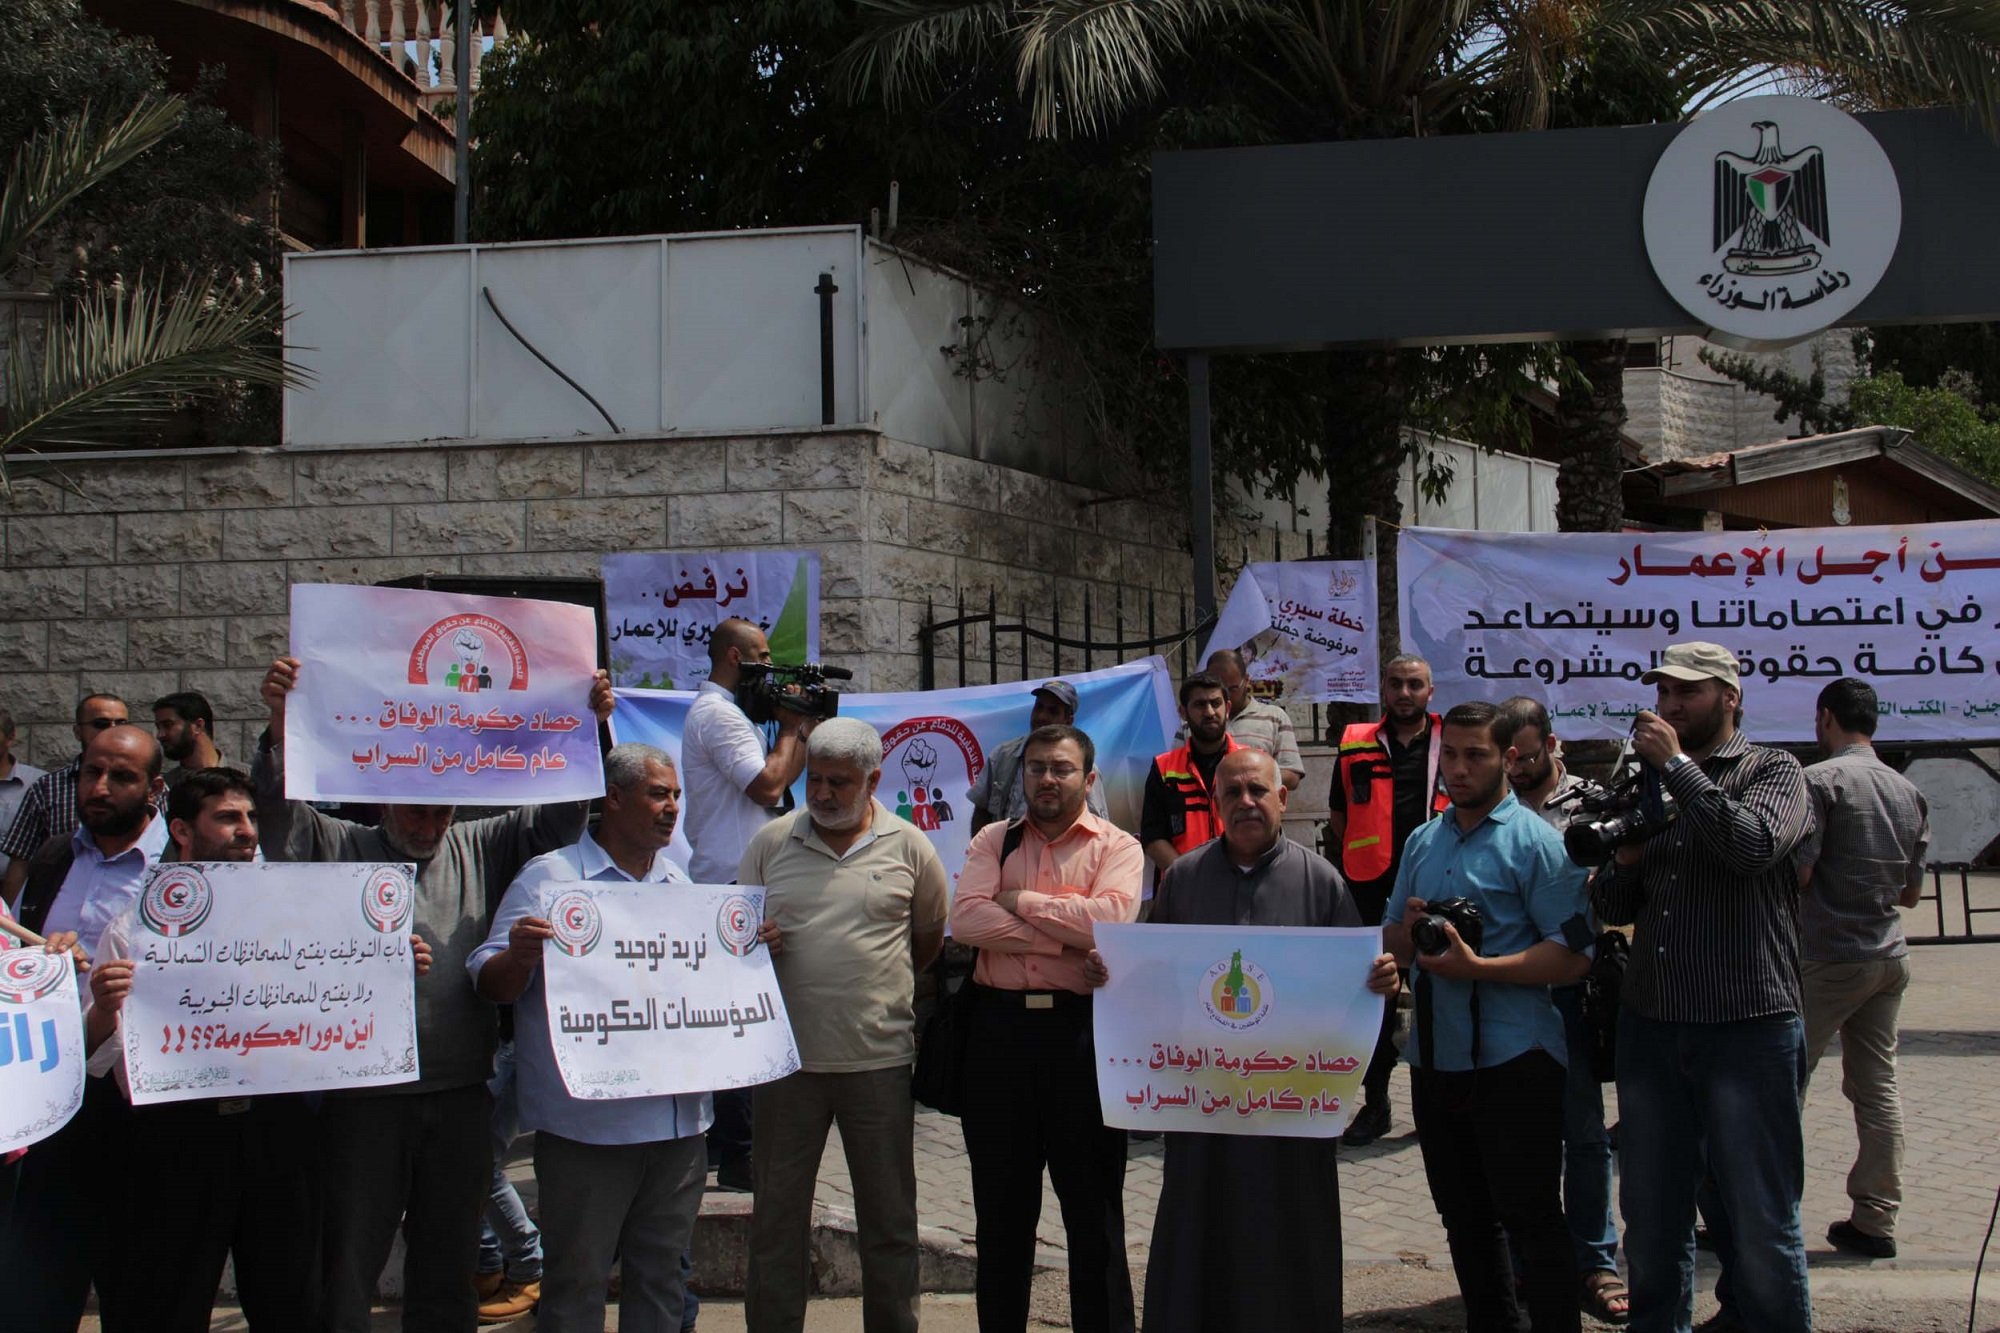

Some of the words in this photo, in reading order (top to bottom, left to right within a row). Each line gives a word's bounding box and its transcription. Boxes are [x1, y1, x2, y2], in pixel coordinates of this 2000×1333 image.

[1696, 272, 1775, 311] الوزراء
[1796, 536, 1908, 585] أجل
[459, 617, 473, 626] عن
[1327, 607, 1365, 632] خطة
[1463, 601, 1679, 636] وسيتصاعد
[1691, 597, 1904, 630] اعتصاماتنا
[1915, 594, 1982, 640] في
[610, 618, 678, 644] للإعمار
[1304, 626, 1359, 656] مرفوضة
[1853, 643, 1985, 676] كافة
[378, 699, 443, 733] الوفاق
[448, 701, 526, 735] حكومة
[529, 708, 582, 733] حصاد
[1900, 699, 1946, 719] المكتب
[911, 720, 927, 735] عن
[350, 742, 427, 774] السراب
[431, 748, 461, 775] من
[464, 743, 527, 775] كامل
[530, 746, 568, 777] عام
[144, 940, 213, 971] الشمالية
[215, 938, 292, 966] للمحافظات
[294, 944, 328, 970] يفتح
[329, 937, 382, 967] التوظيف
[383, 935, 407, 962] باب
[614, 933, 666, 972] توحيد
[672, 933, 707, 971] نريد
[178, 983, 240, 1015] الجنوبية
[242, 981, 317, 1010] للمحافظات
[319, 989, 352, 1013] يفتح
[355, 983, 373, 1004] ولا
[559, 997, 659, 1046] الحكومية
[663, 992, 776, 1038] المؤسسات
[310, 1023, 344, 1051] دور
[345, 1012, 374, 1051] أين
[1148, 1042, 1209, 1075] الوفاق
[1214, 1047, 1298, 1078] حكومة
[1305, 1049, 1360, 1075] حصاد
[1125, 1082, 1197, 1113] السراب
[1200, 1088, 1231, 1117] من
[1236, 1086, 1304, 1118] كامل
[1308, 1089, 1341, 1120] عام
